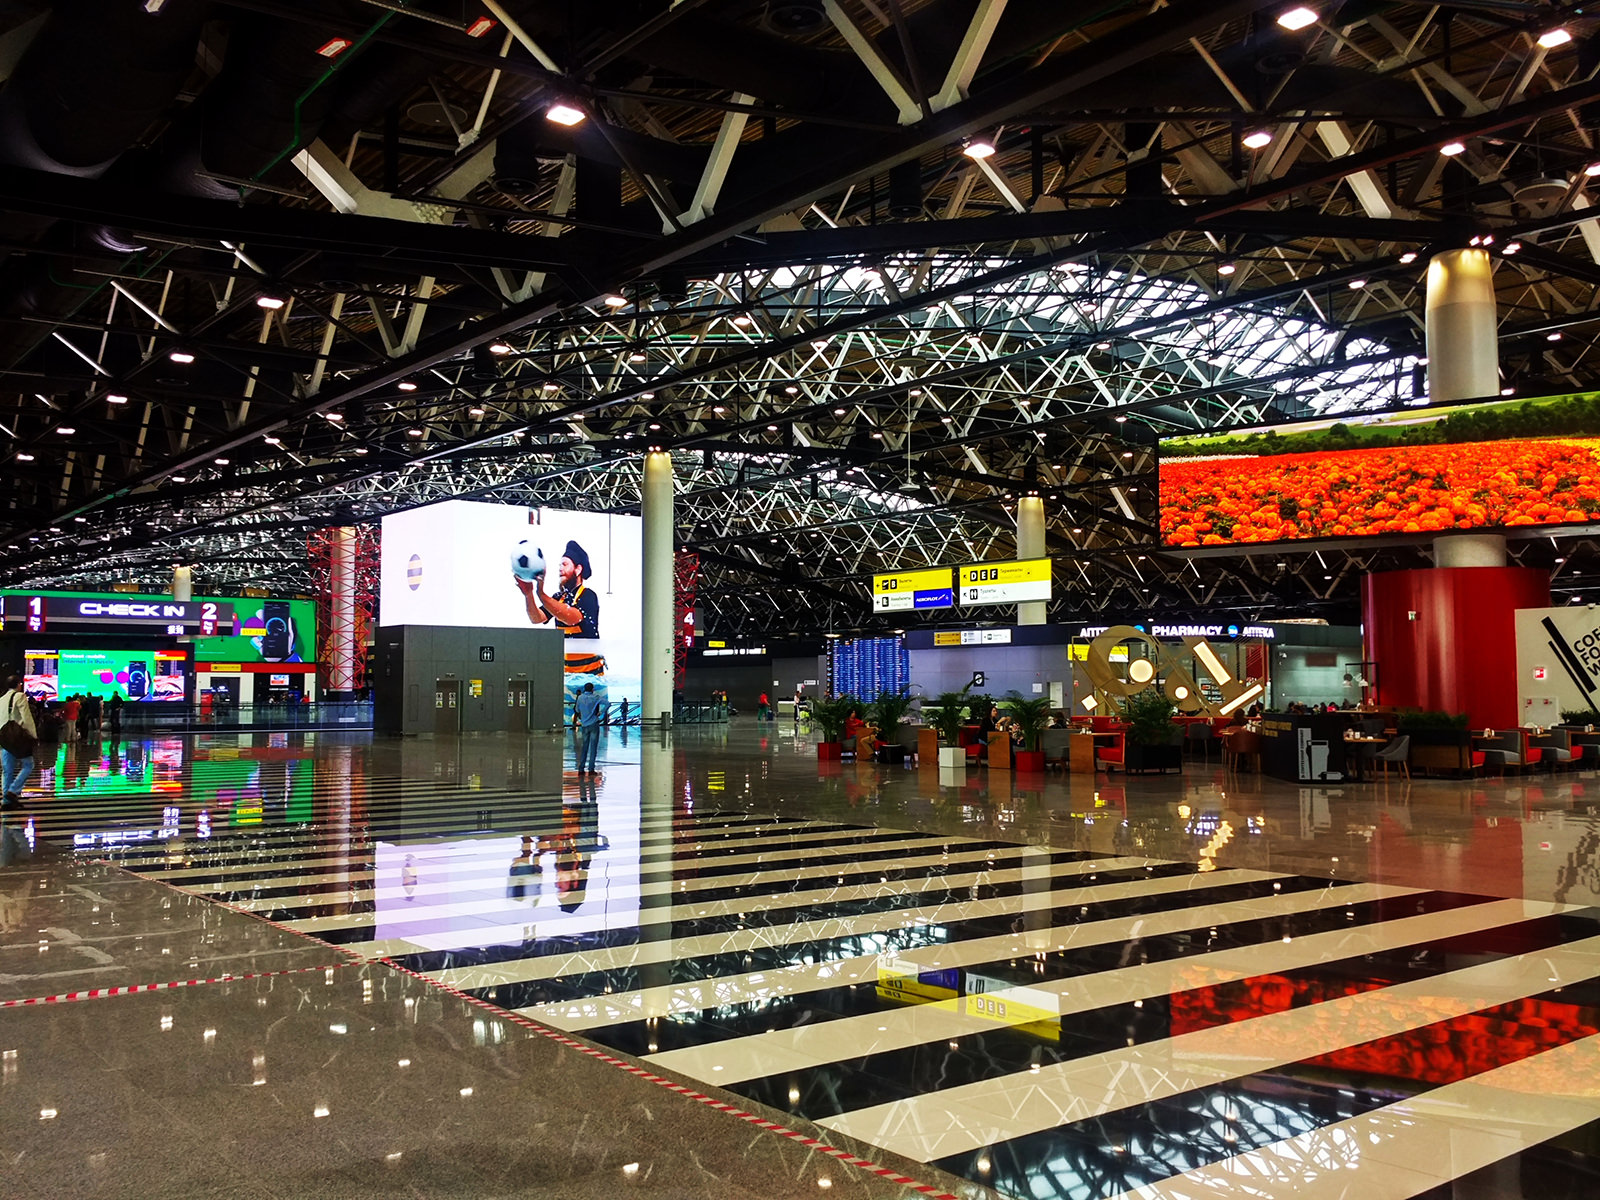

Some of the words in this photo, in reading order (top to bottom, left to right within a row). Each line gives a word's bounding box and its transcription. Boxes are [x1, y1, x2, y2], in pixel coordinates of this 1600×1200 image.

[971, 572, 977, 580] D
[982, 571, 986, 580] E
[992, 570, 997, 578] F
[30, 597, 41, 615] 1
[80, 603, 160, 616] CHECK
[163, 606, 184, 617] IN
[202, 603, 217, 620] 2
[684, 612, 694, 626] 4
[1152, 626, 1223, 636] PHARMACY
[1242, 626, 1274, 638] АПТЕКА
